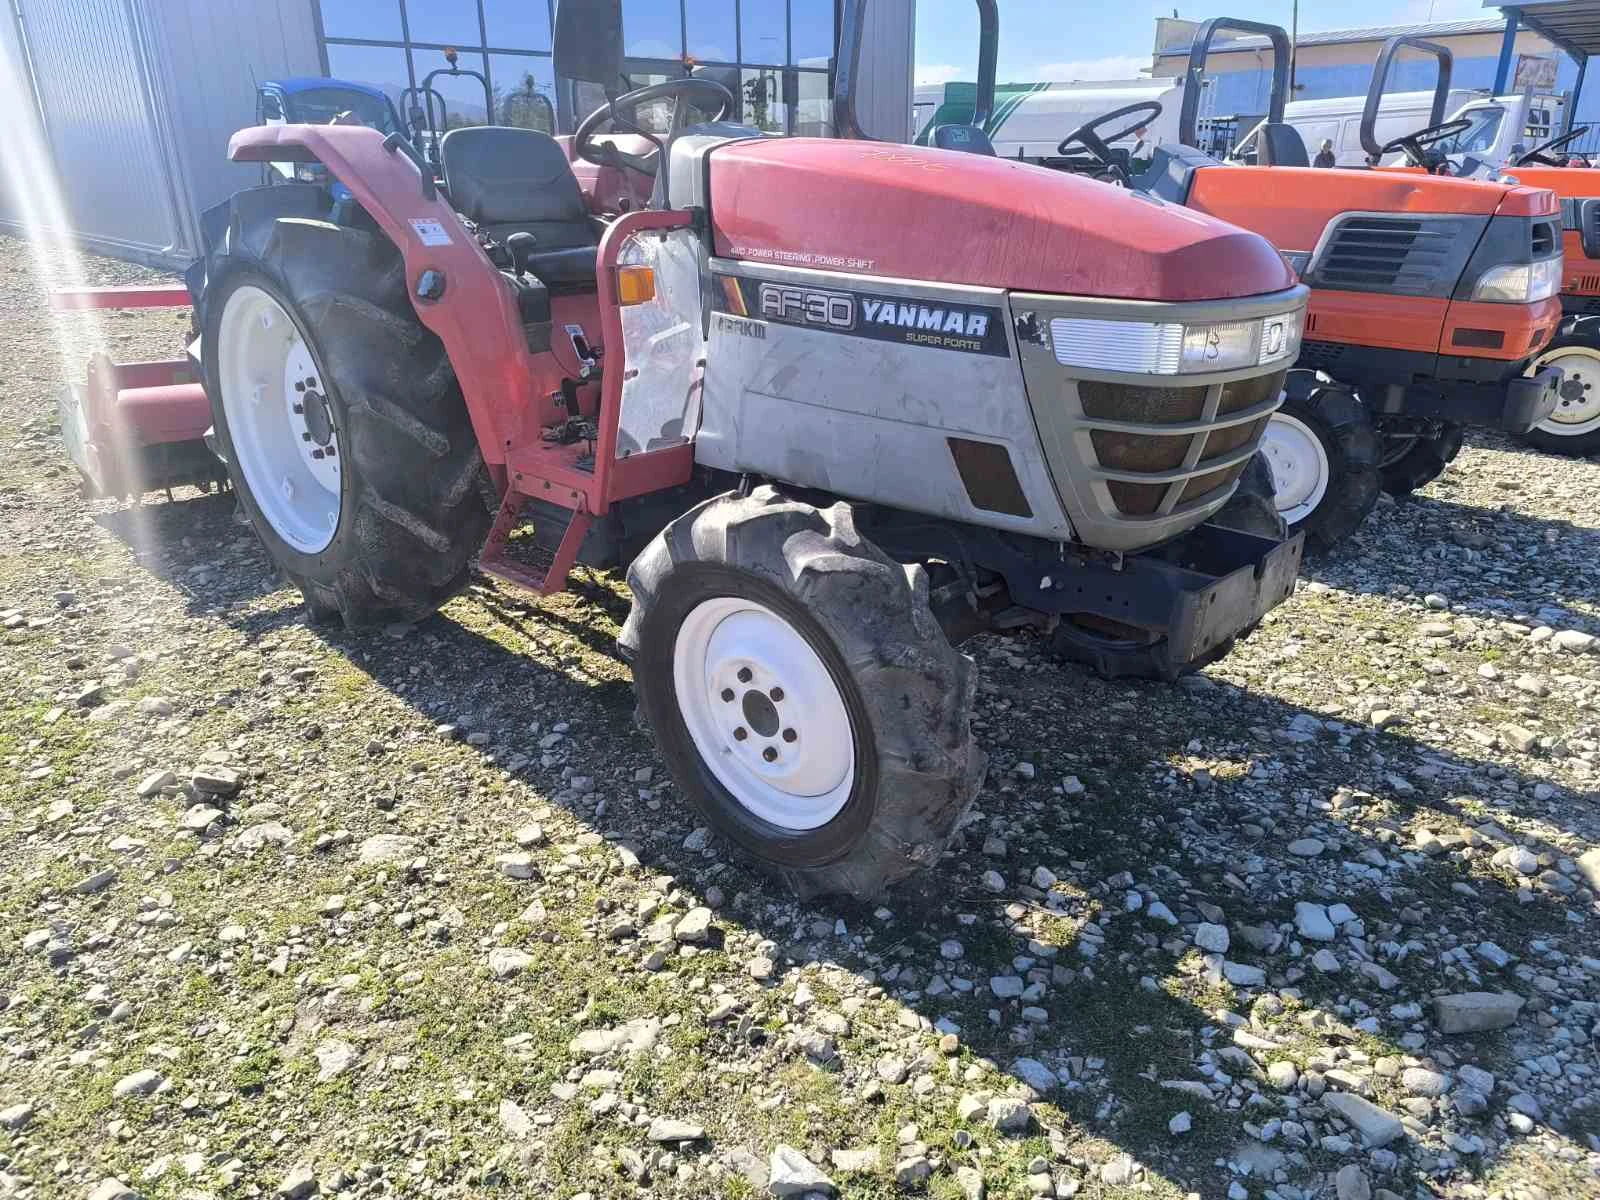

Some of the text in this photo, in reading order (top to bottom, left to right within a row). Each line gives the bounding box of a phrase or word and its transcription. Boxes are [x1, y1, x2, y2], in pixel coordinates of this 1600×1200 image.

[862, 298, 988, 337] YANMAR
[905, 332, 981, 350] SUPER FORTE
